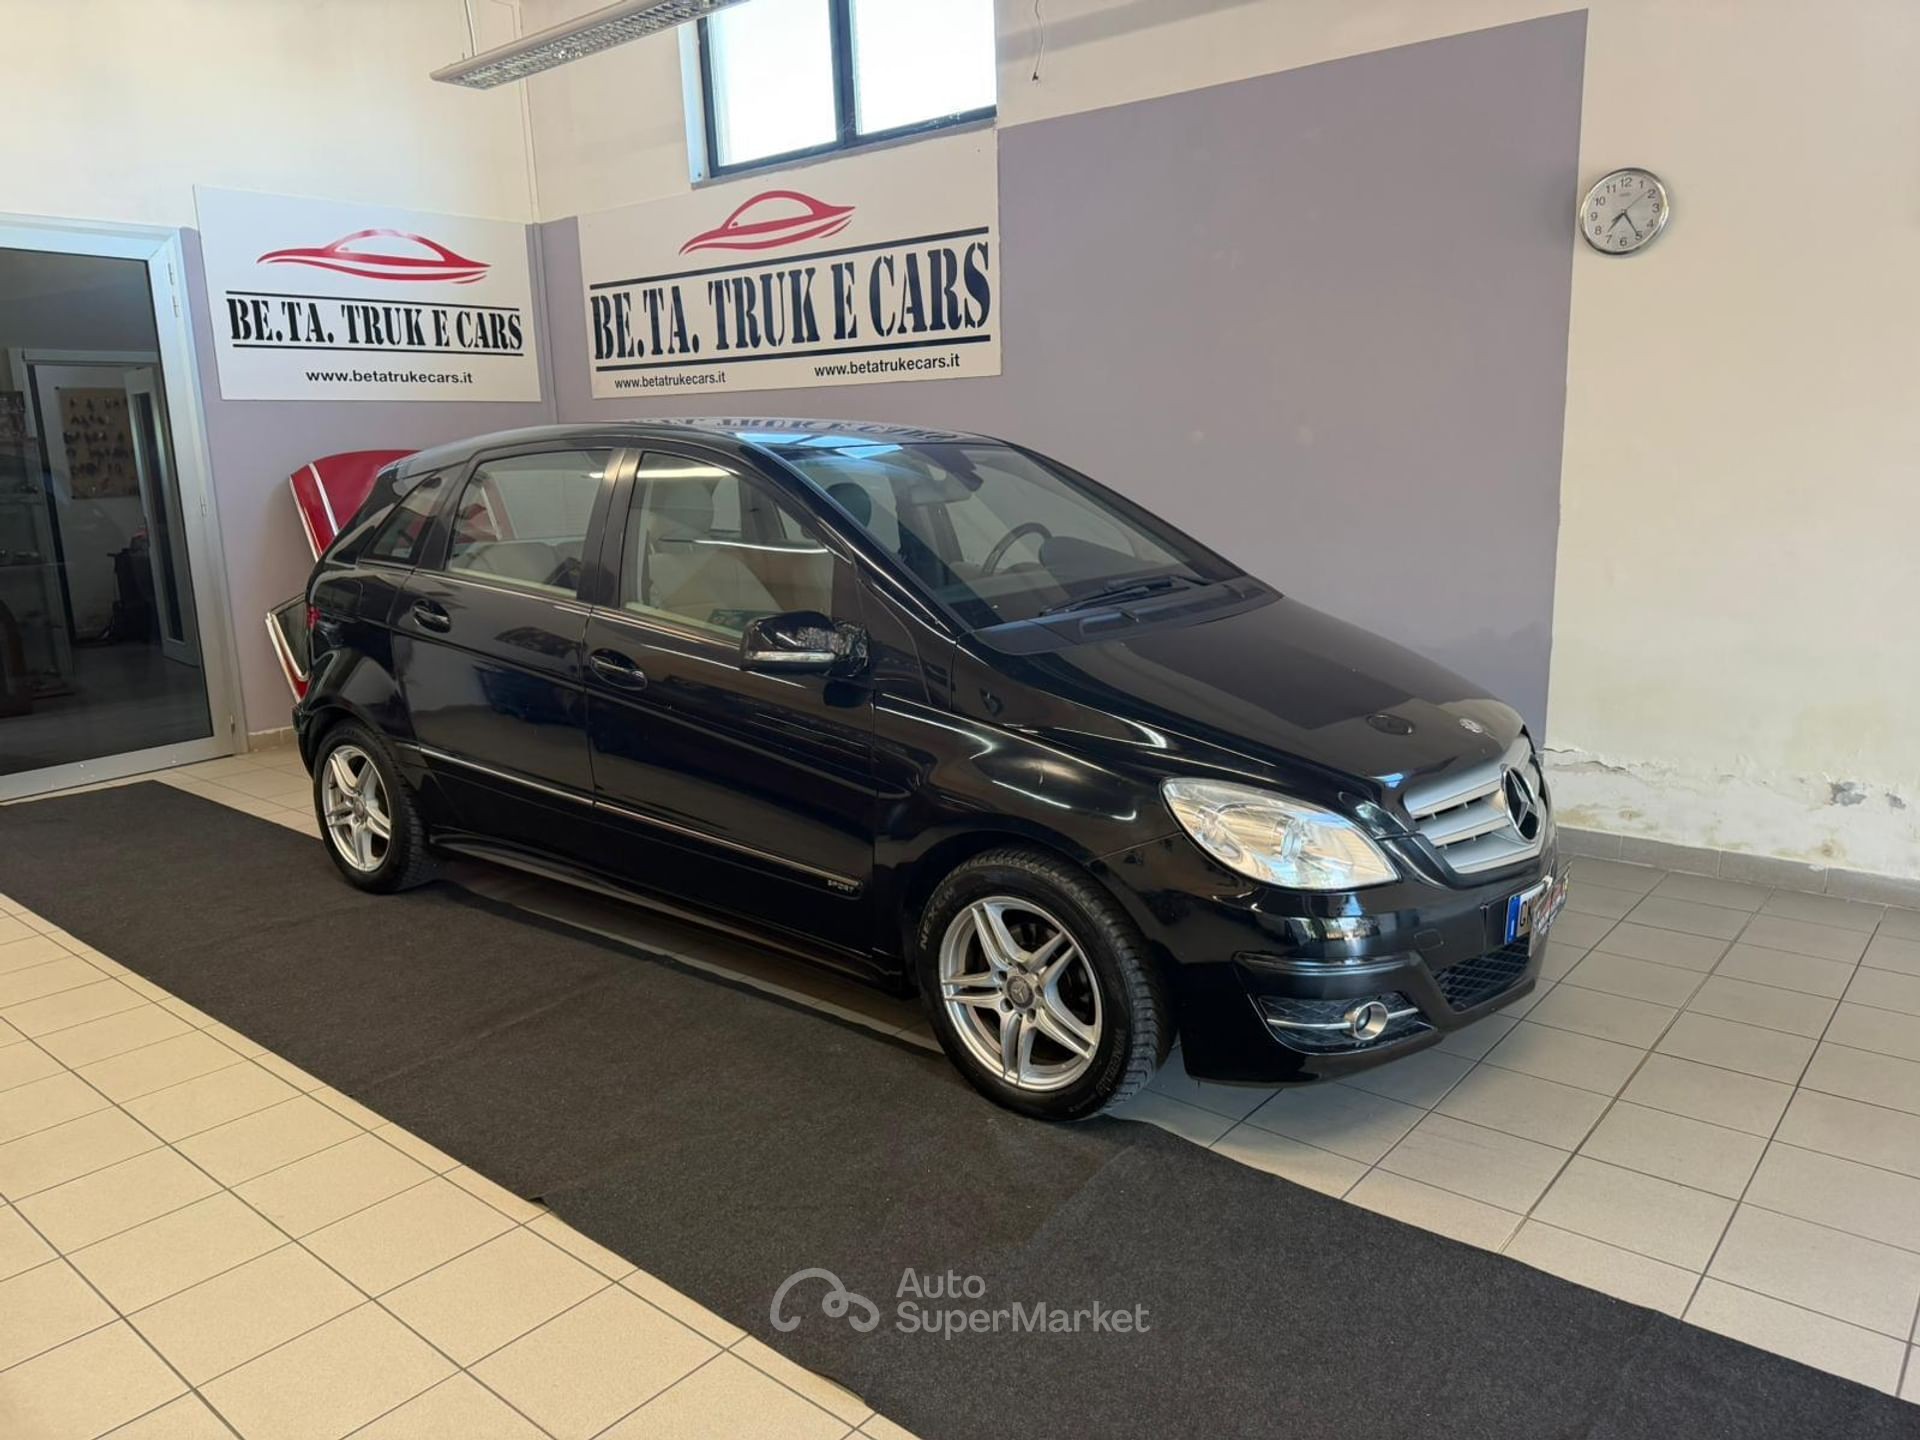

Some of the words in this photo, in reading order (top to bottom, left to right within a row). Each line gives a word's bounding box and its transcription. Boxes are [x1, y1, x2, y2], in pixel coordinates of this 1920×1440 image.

[1620, 177, 1632, 187] 12
[1606, 184, 1616, 193] 11
[1647, 189, 1656, 199] 2
[1595, 196, 1606, 206] 10
[1652, 203, 1660, 213] 3
[1591, 212, 1598, 221] 9
[1646, 219, 1654, 228] 4
[1594, 225, 1602, 236] 8
[1605, 234, 1613, 244] 7
[1620, 238, 1627, 246] 6
[590, 286, 700, 360] BE.TA.
[708, 266, 820, 351] TRUK
[830, 261, 858, 341] E
[869, 241, 991, 338] CARS
[226, 298, 335, 344] BE.TA.
[341, 303, 426, 346] TRUK
[432, 309, 451, 347] E
[456, 310, 524, 350] CARS
[813, 353, 961, 377] www.betatrukecars.it
[306, 369, 473, 384] www.betatrukecars.it
[614, 370, 727, 390] www.betatrukecars.it
